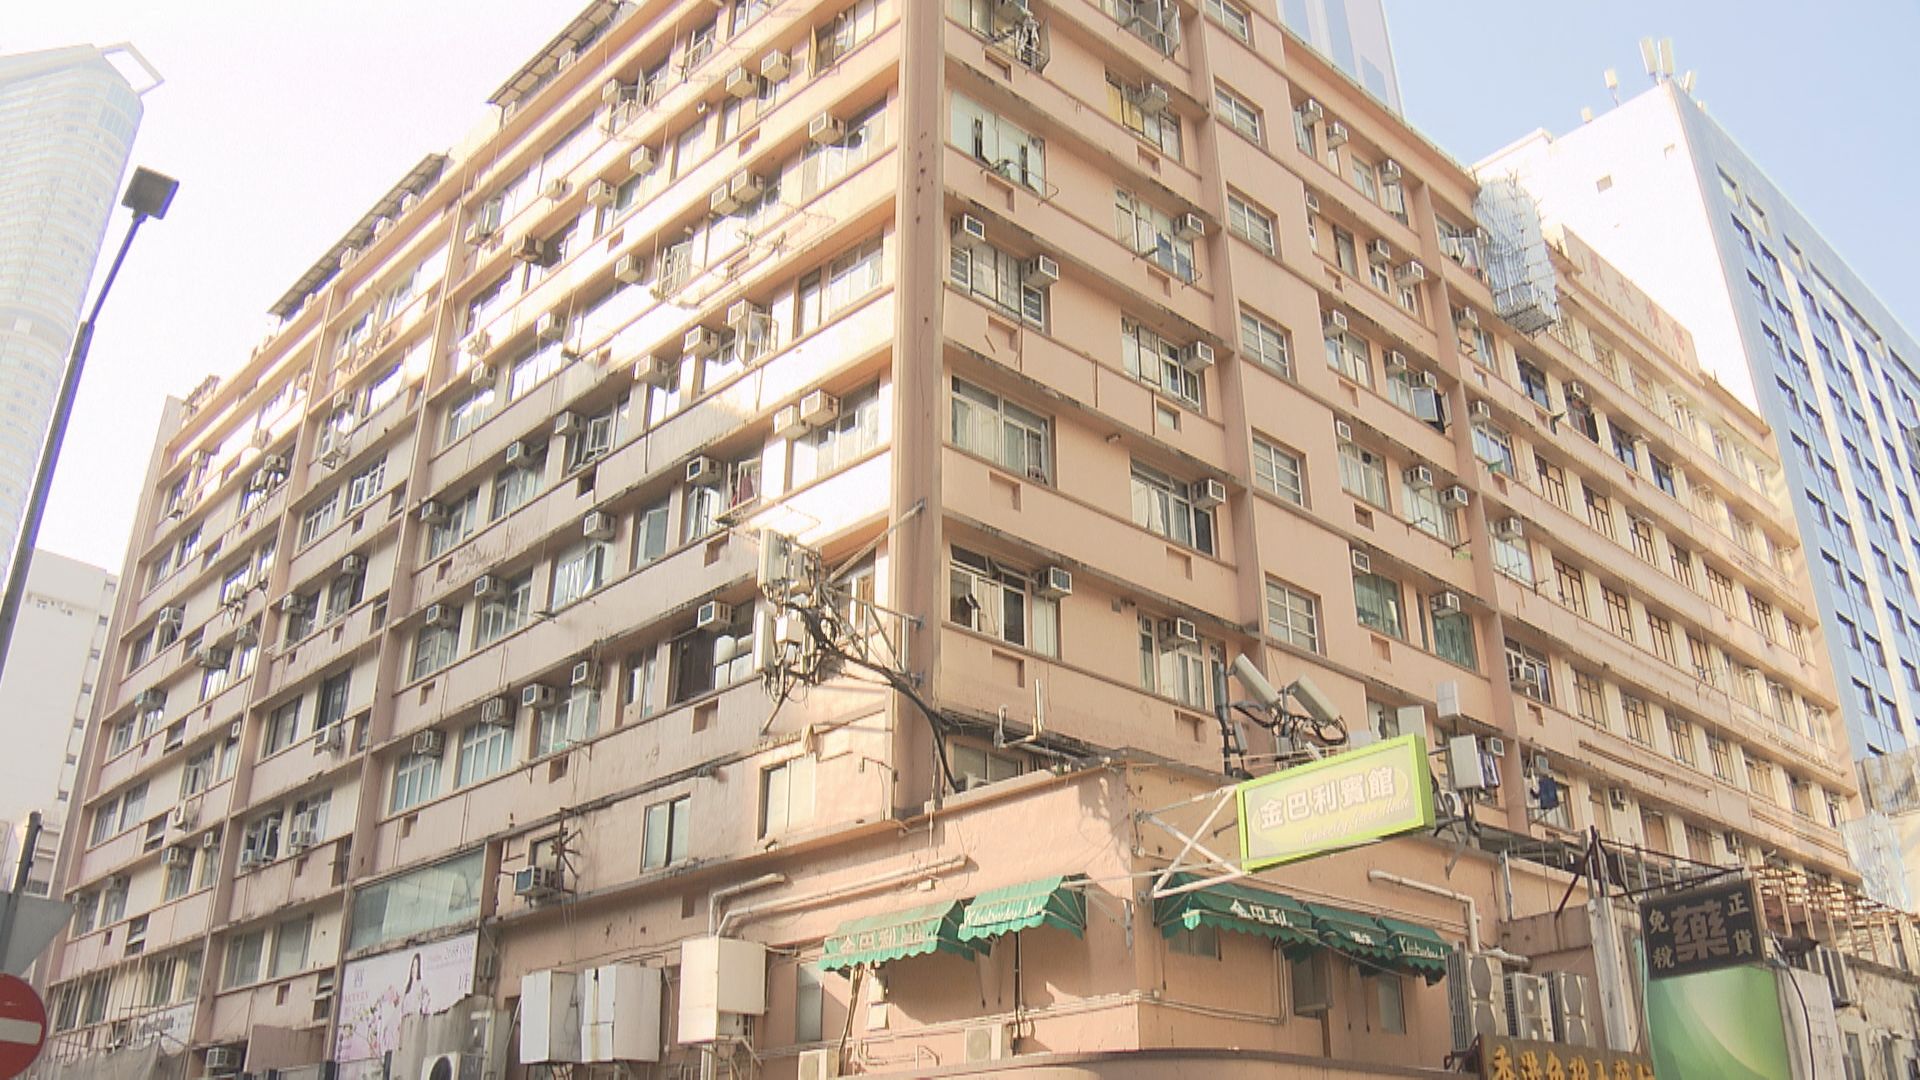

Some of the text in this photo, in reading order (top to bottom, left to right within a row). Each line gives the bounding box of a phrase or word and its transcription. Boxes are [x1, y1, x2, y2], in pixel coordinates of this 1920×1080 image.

[1259, 766, 1395, 829] 金巴利賓館
